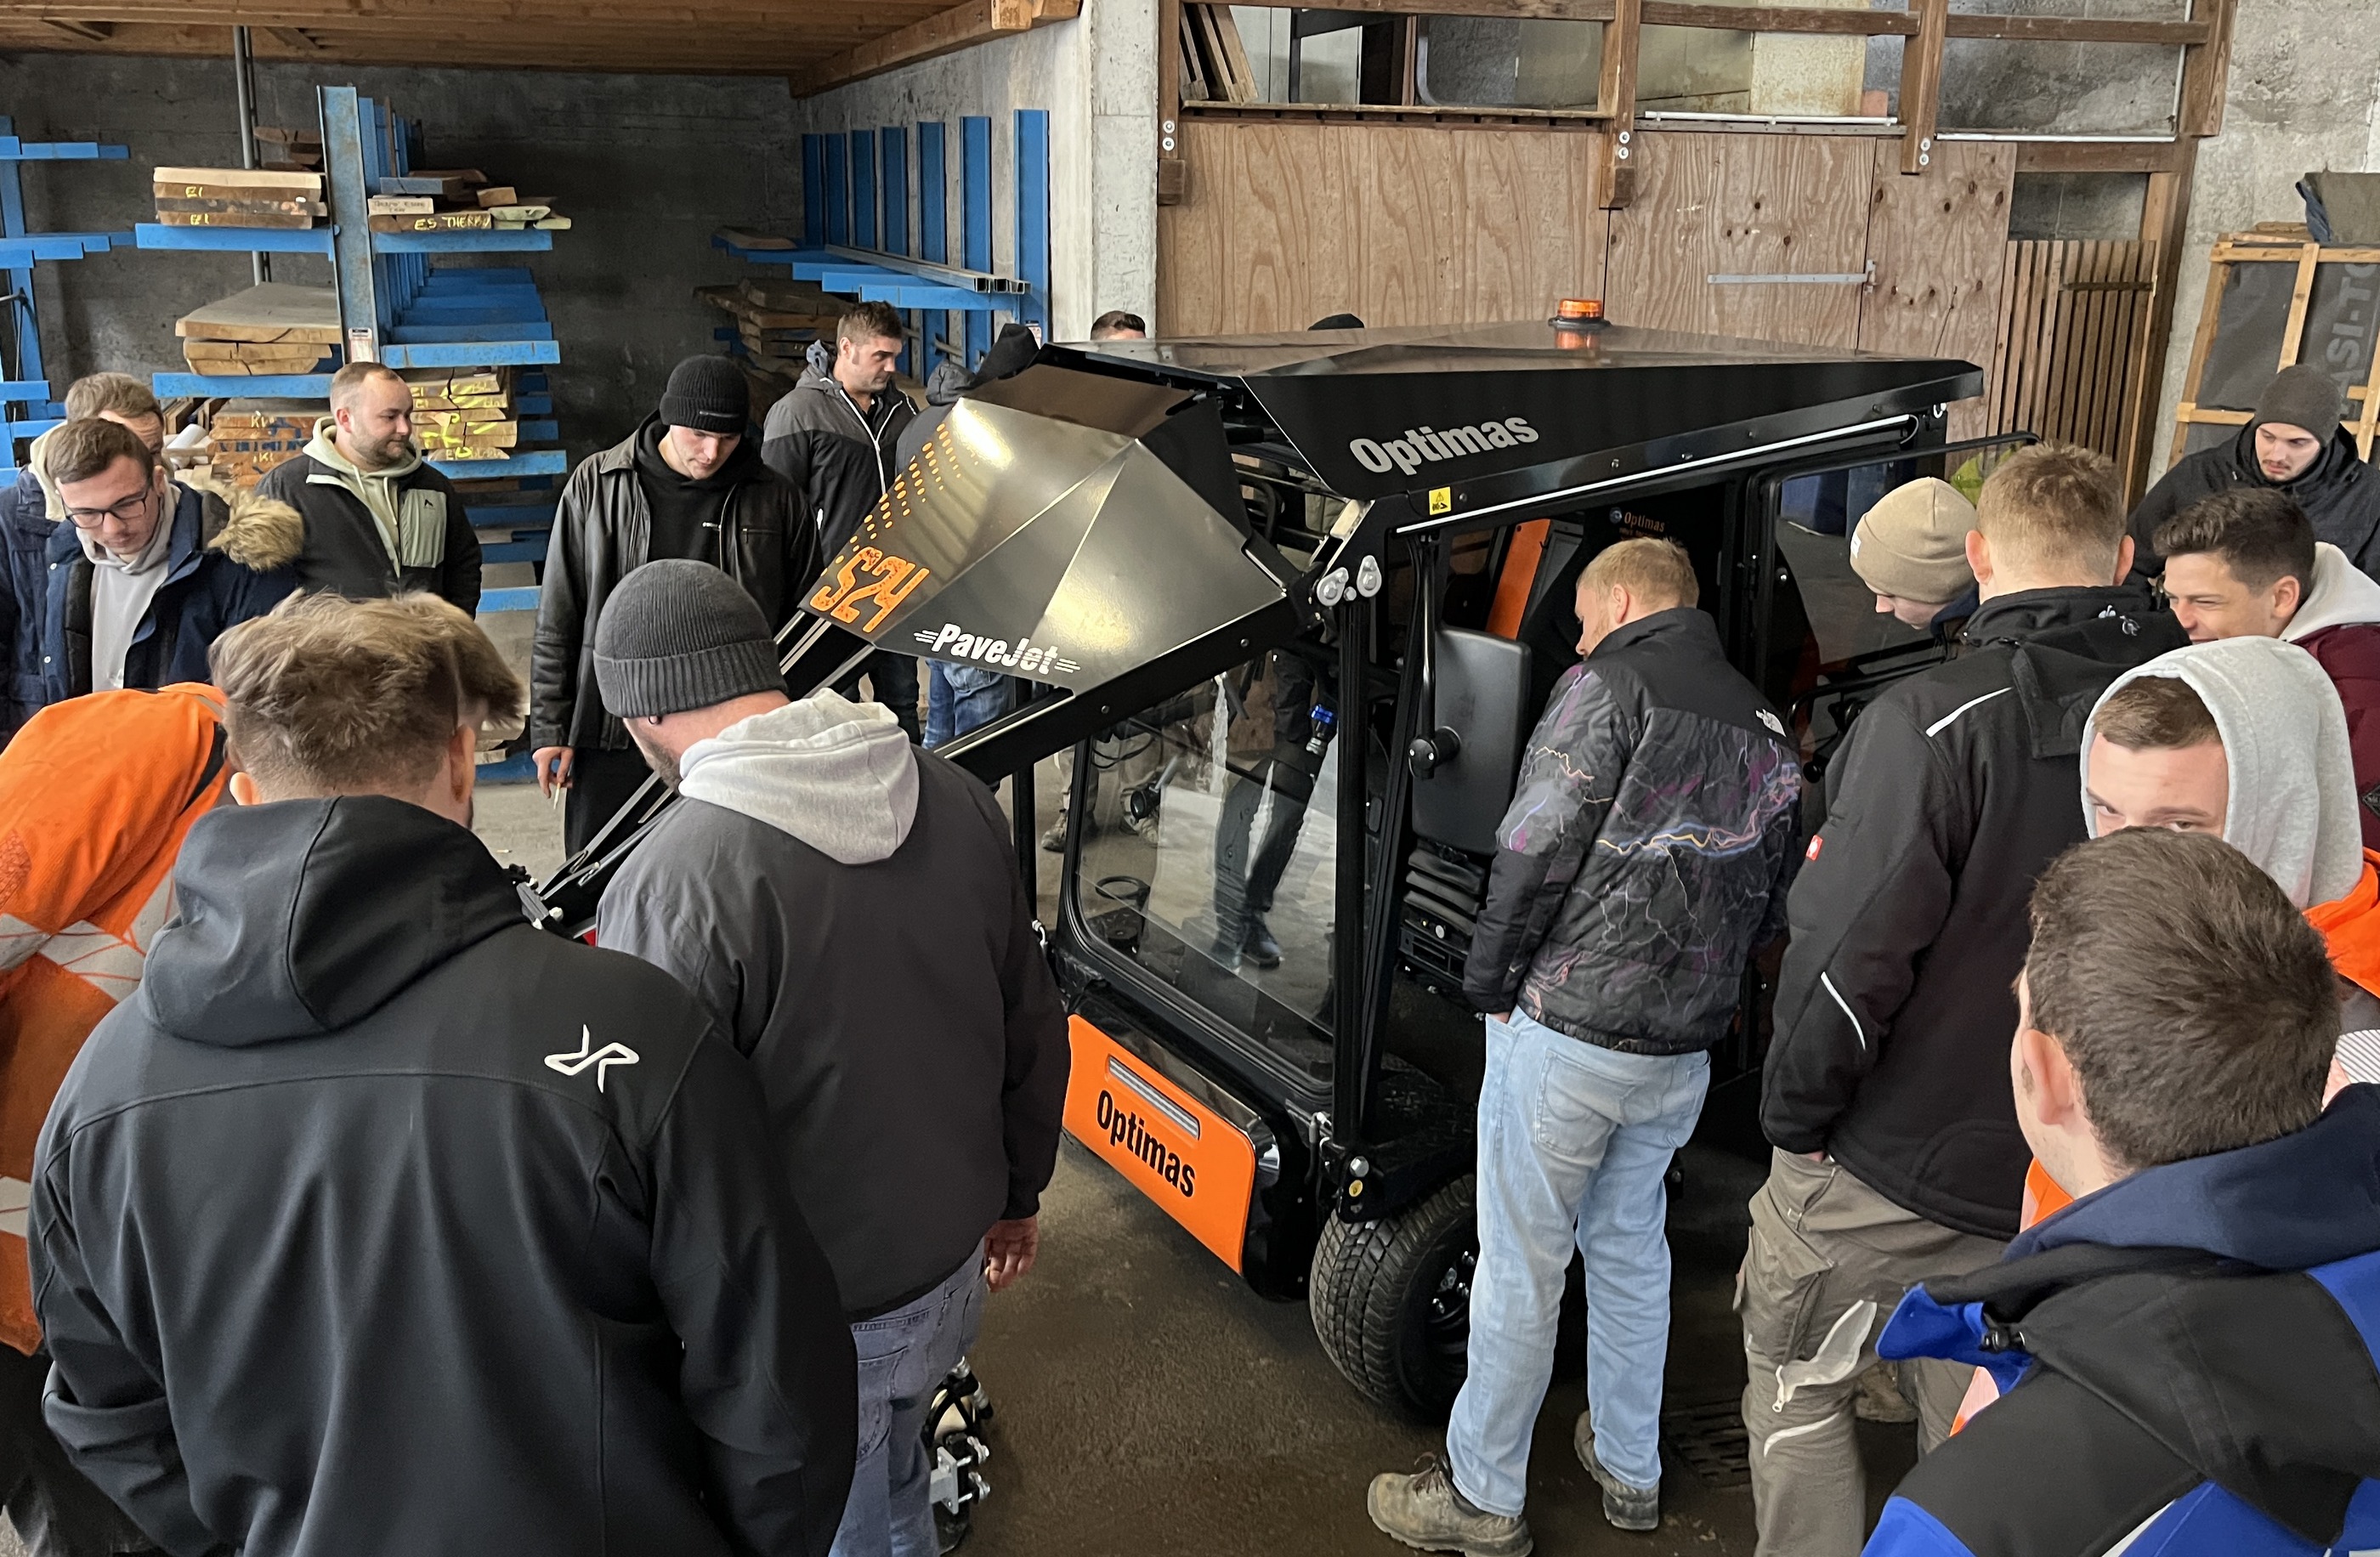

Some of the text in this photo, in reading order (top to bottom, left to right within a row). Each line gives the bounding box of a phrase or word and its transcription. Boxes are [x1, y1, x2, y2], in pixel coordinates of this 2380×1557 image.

[414, 218, 438, 231] ES
[1349, 416, 1539, 476] Optimas
[1624, 511, 1665, 533] Optimas
[810, 546, 930, 633] S24
[931, 623, 1059, 675] PaveJet
[1096, 1089, 1196, 1198] Optimas
